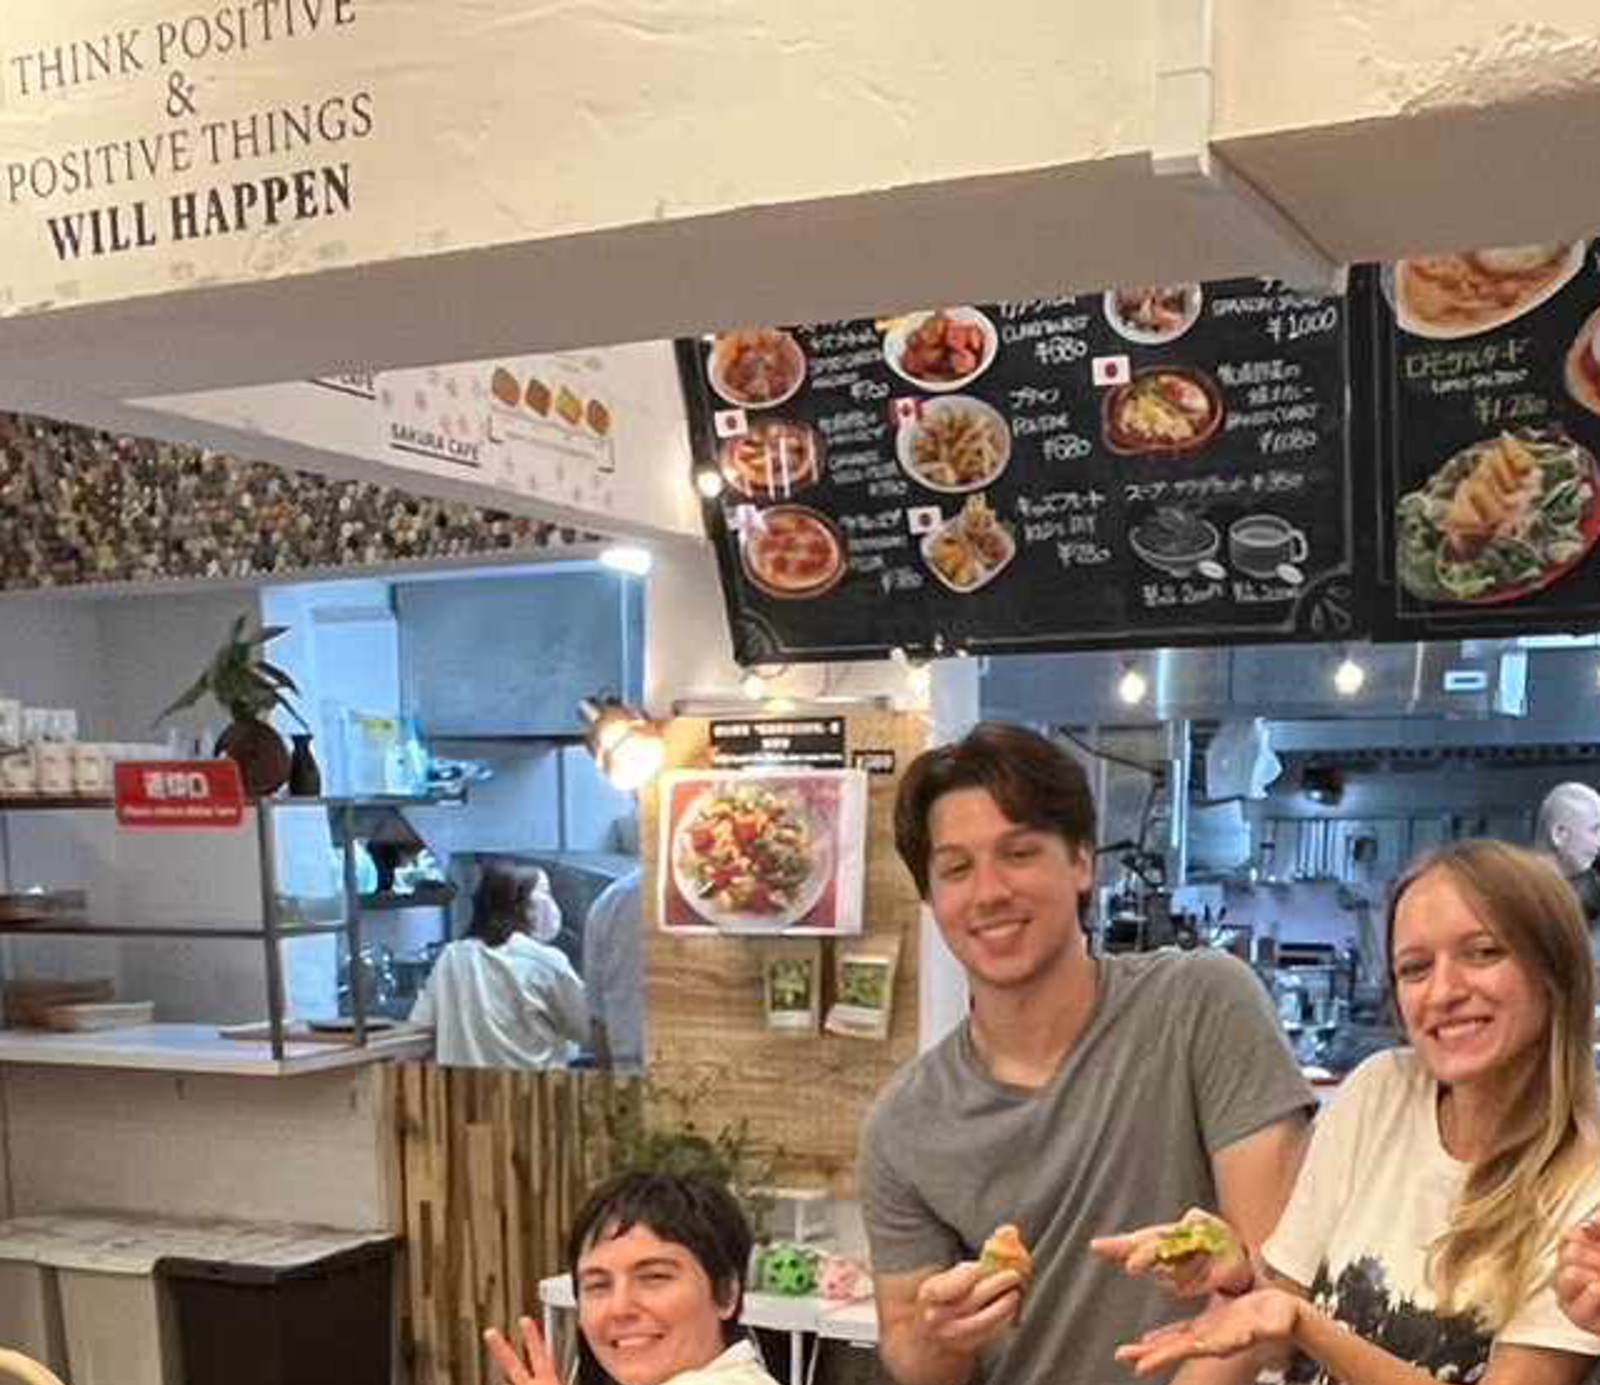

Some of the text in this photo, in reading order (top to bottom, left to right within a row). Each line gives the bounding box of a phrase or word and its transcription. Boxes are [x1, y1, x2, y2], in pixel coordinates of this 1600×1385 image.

[11, 0, 356, 96] THINK POSITIVE
[165, 70, 198, 119] &
[7, 92, 374, 202] POSITIVE THINGS
[48, 162, 352, 262] WILL HAPPEN
[391, 422, 444, 450] SAKURA
